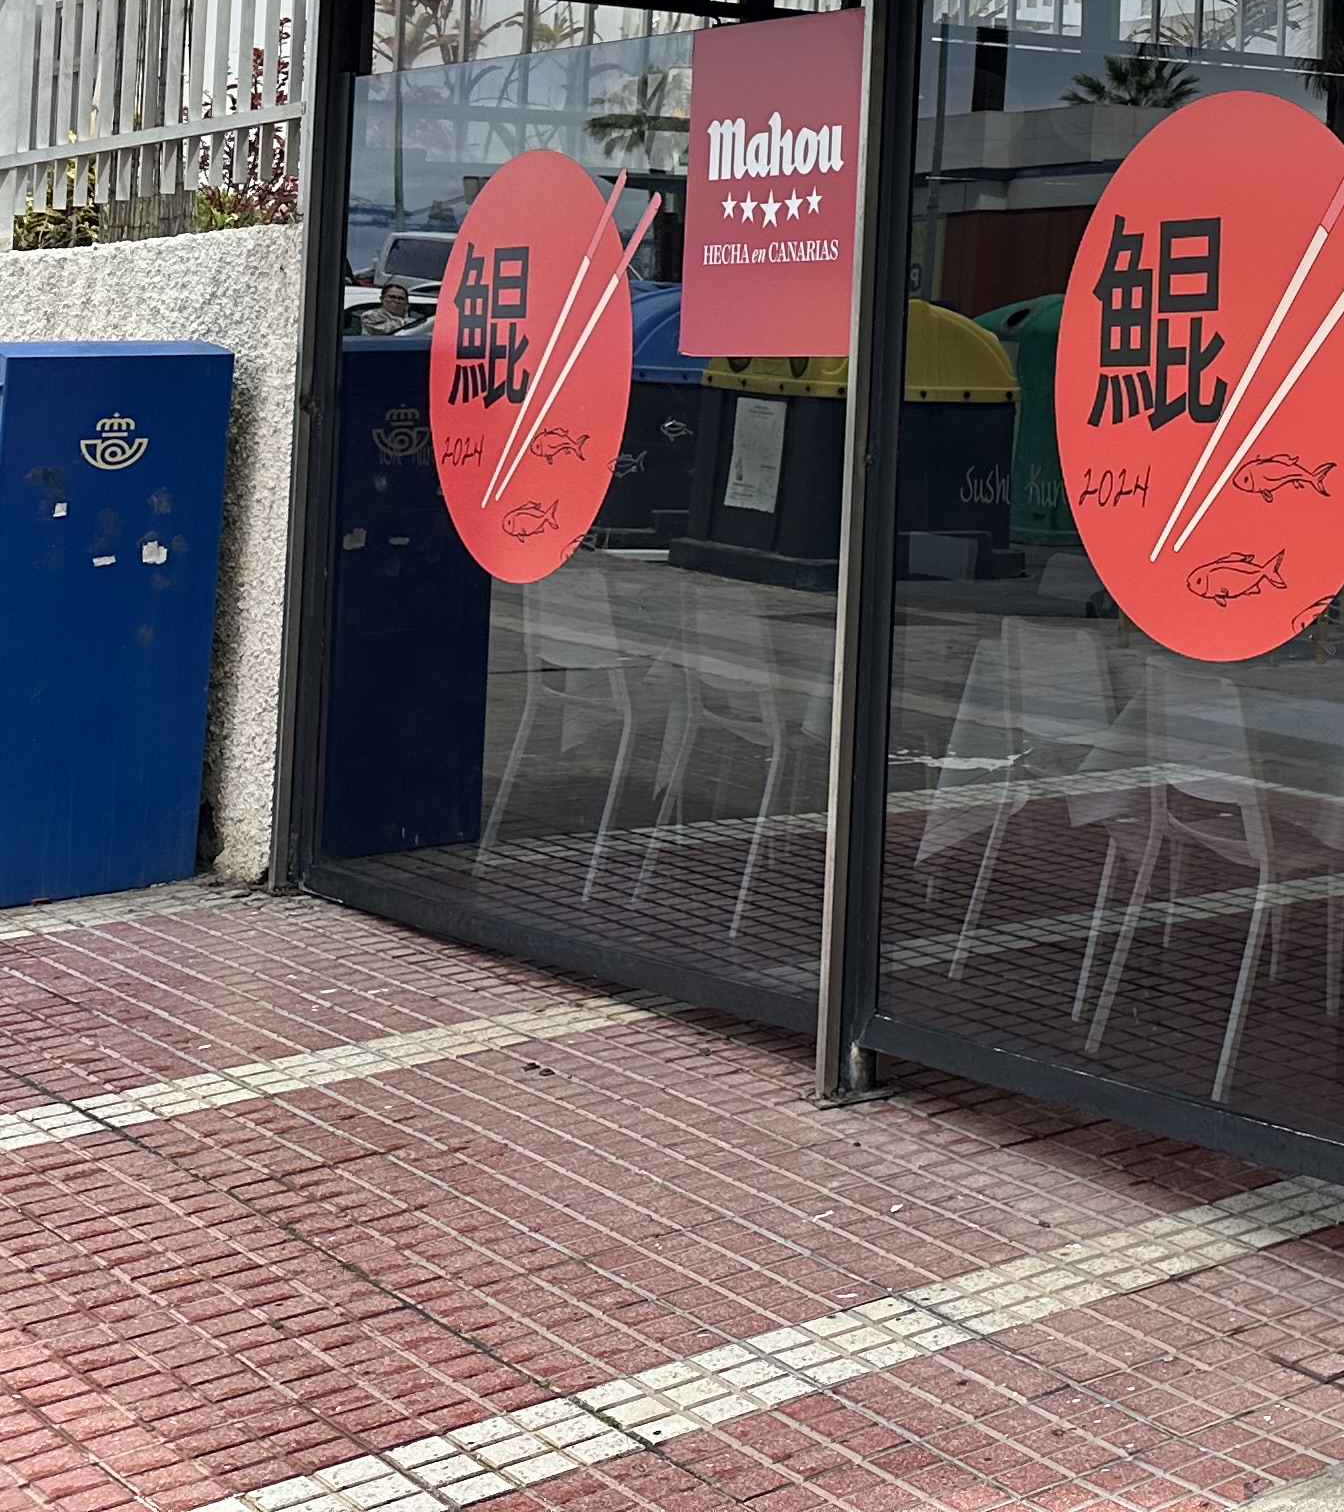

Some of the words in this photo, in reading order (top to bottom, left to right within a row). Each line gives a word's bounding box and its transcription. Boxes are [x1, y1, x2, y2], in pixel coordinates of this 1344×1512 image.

[707, 112, 845, 181] Mahou
[703, 244, 750, 265] HECHA
[752, 249, 767, 264] en
[768, 239, 839, 263] CANARIAS
[448, 242, 529, 409] 鯤
[1087, 214, 1227, 431] 鯤
[1079, 465, 1151, 508] 2024
